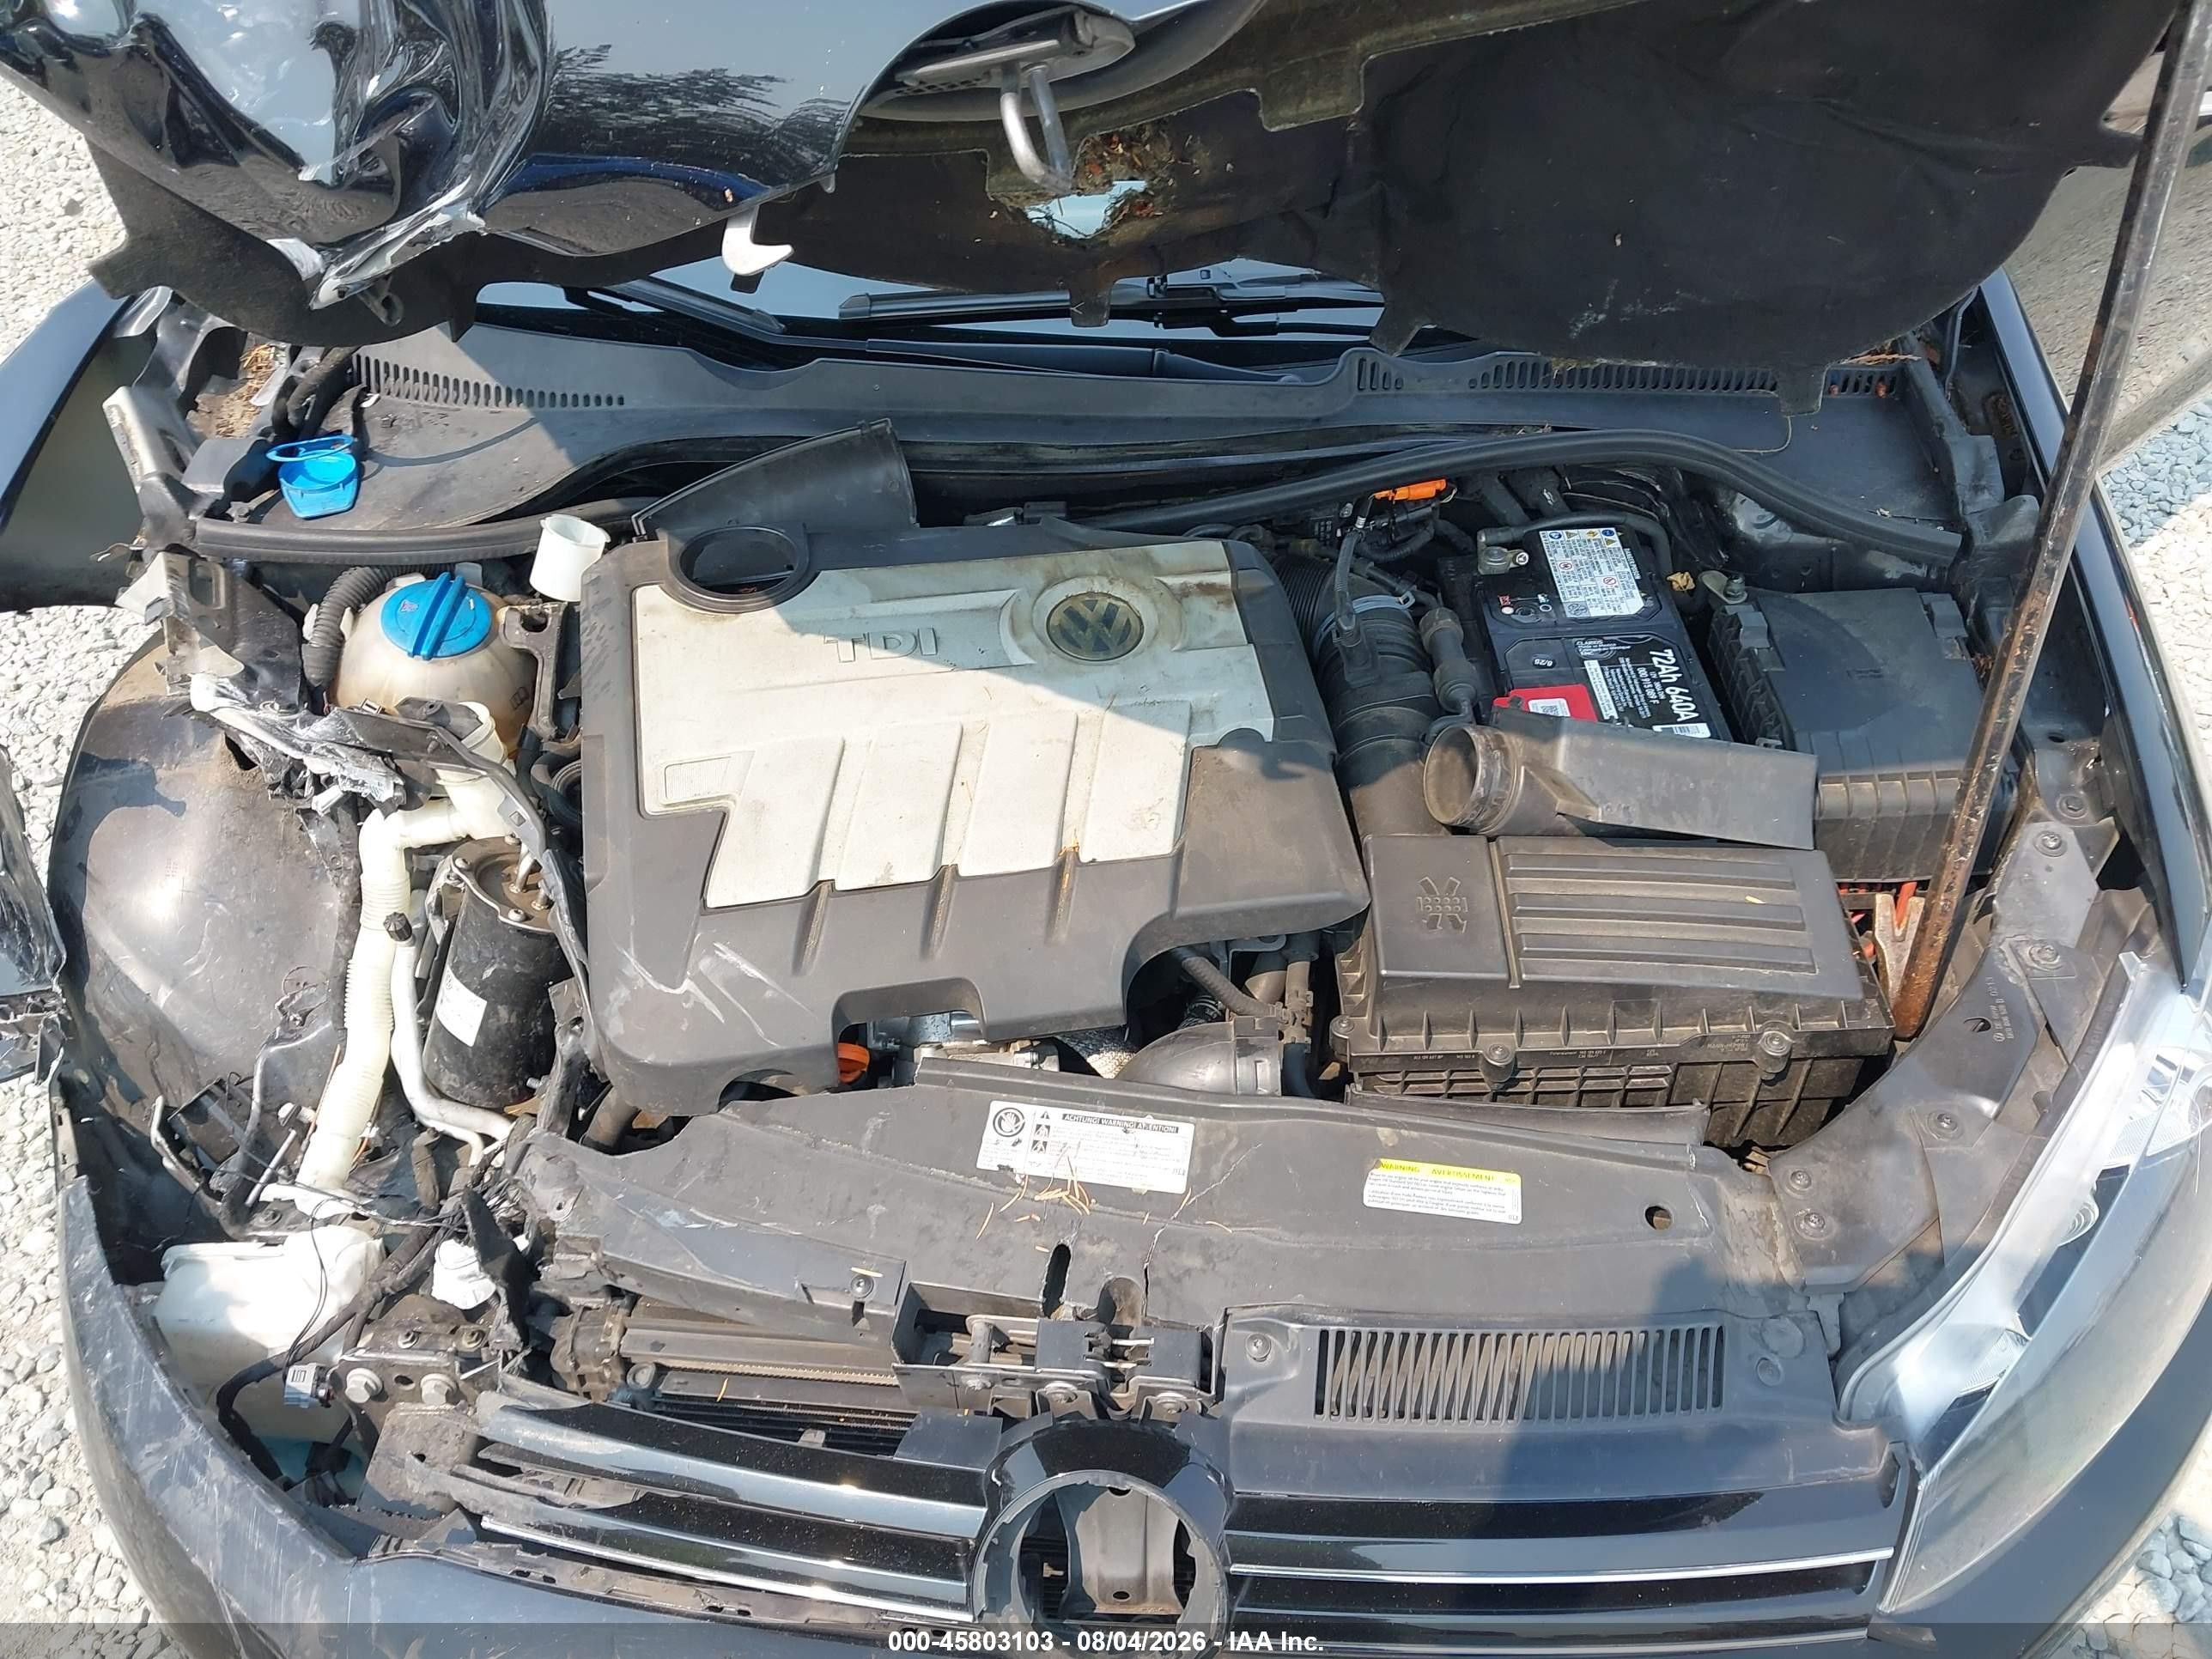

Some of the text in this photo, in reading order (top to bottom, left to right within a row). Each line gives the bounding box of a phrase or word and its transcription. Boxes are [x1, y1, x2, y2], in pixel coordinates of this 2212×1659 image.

[823, 627, 939, 664] TDI
[1649, 648, 1683, 684] 72Ah
[1664, 686, 1699, 722] 640A
[1064, 1114, 1100, 1124] ACHTUNG!
[1101, 1118, 1136, 1129] WARNING!
